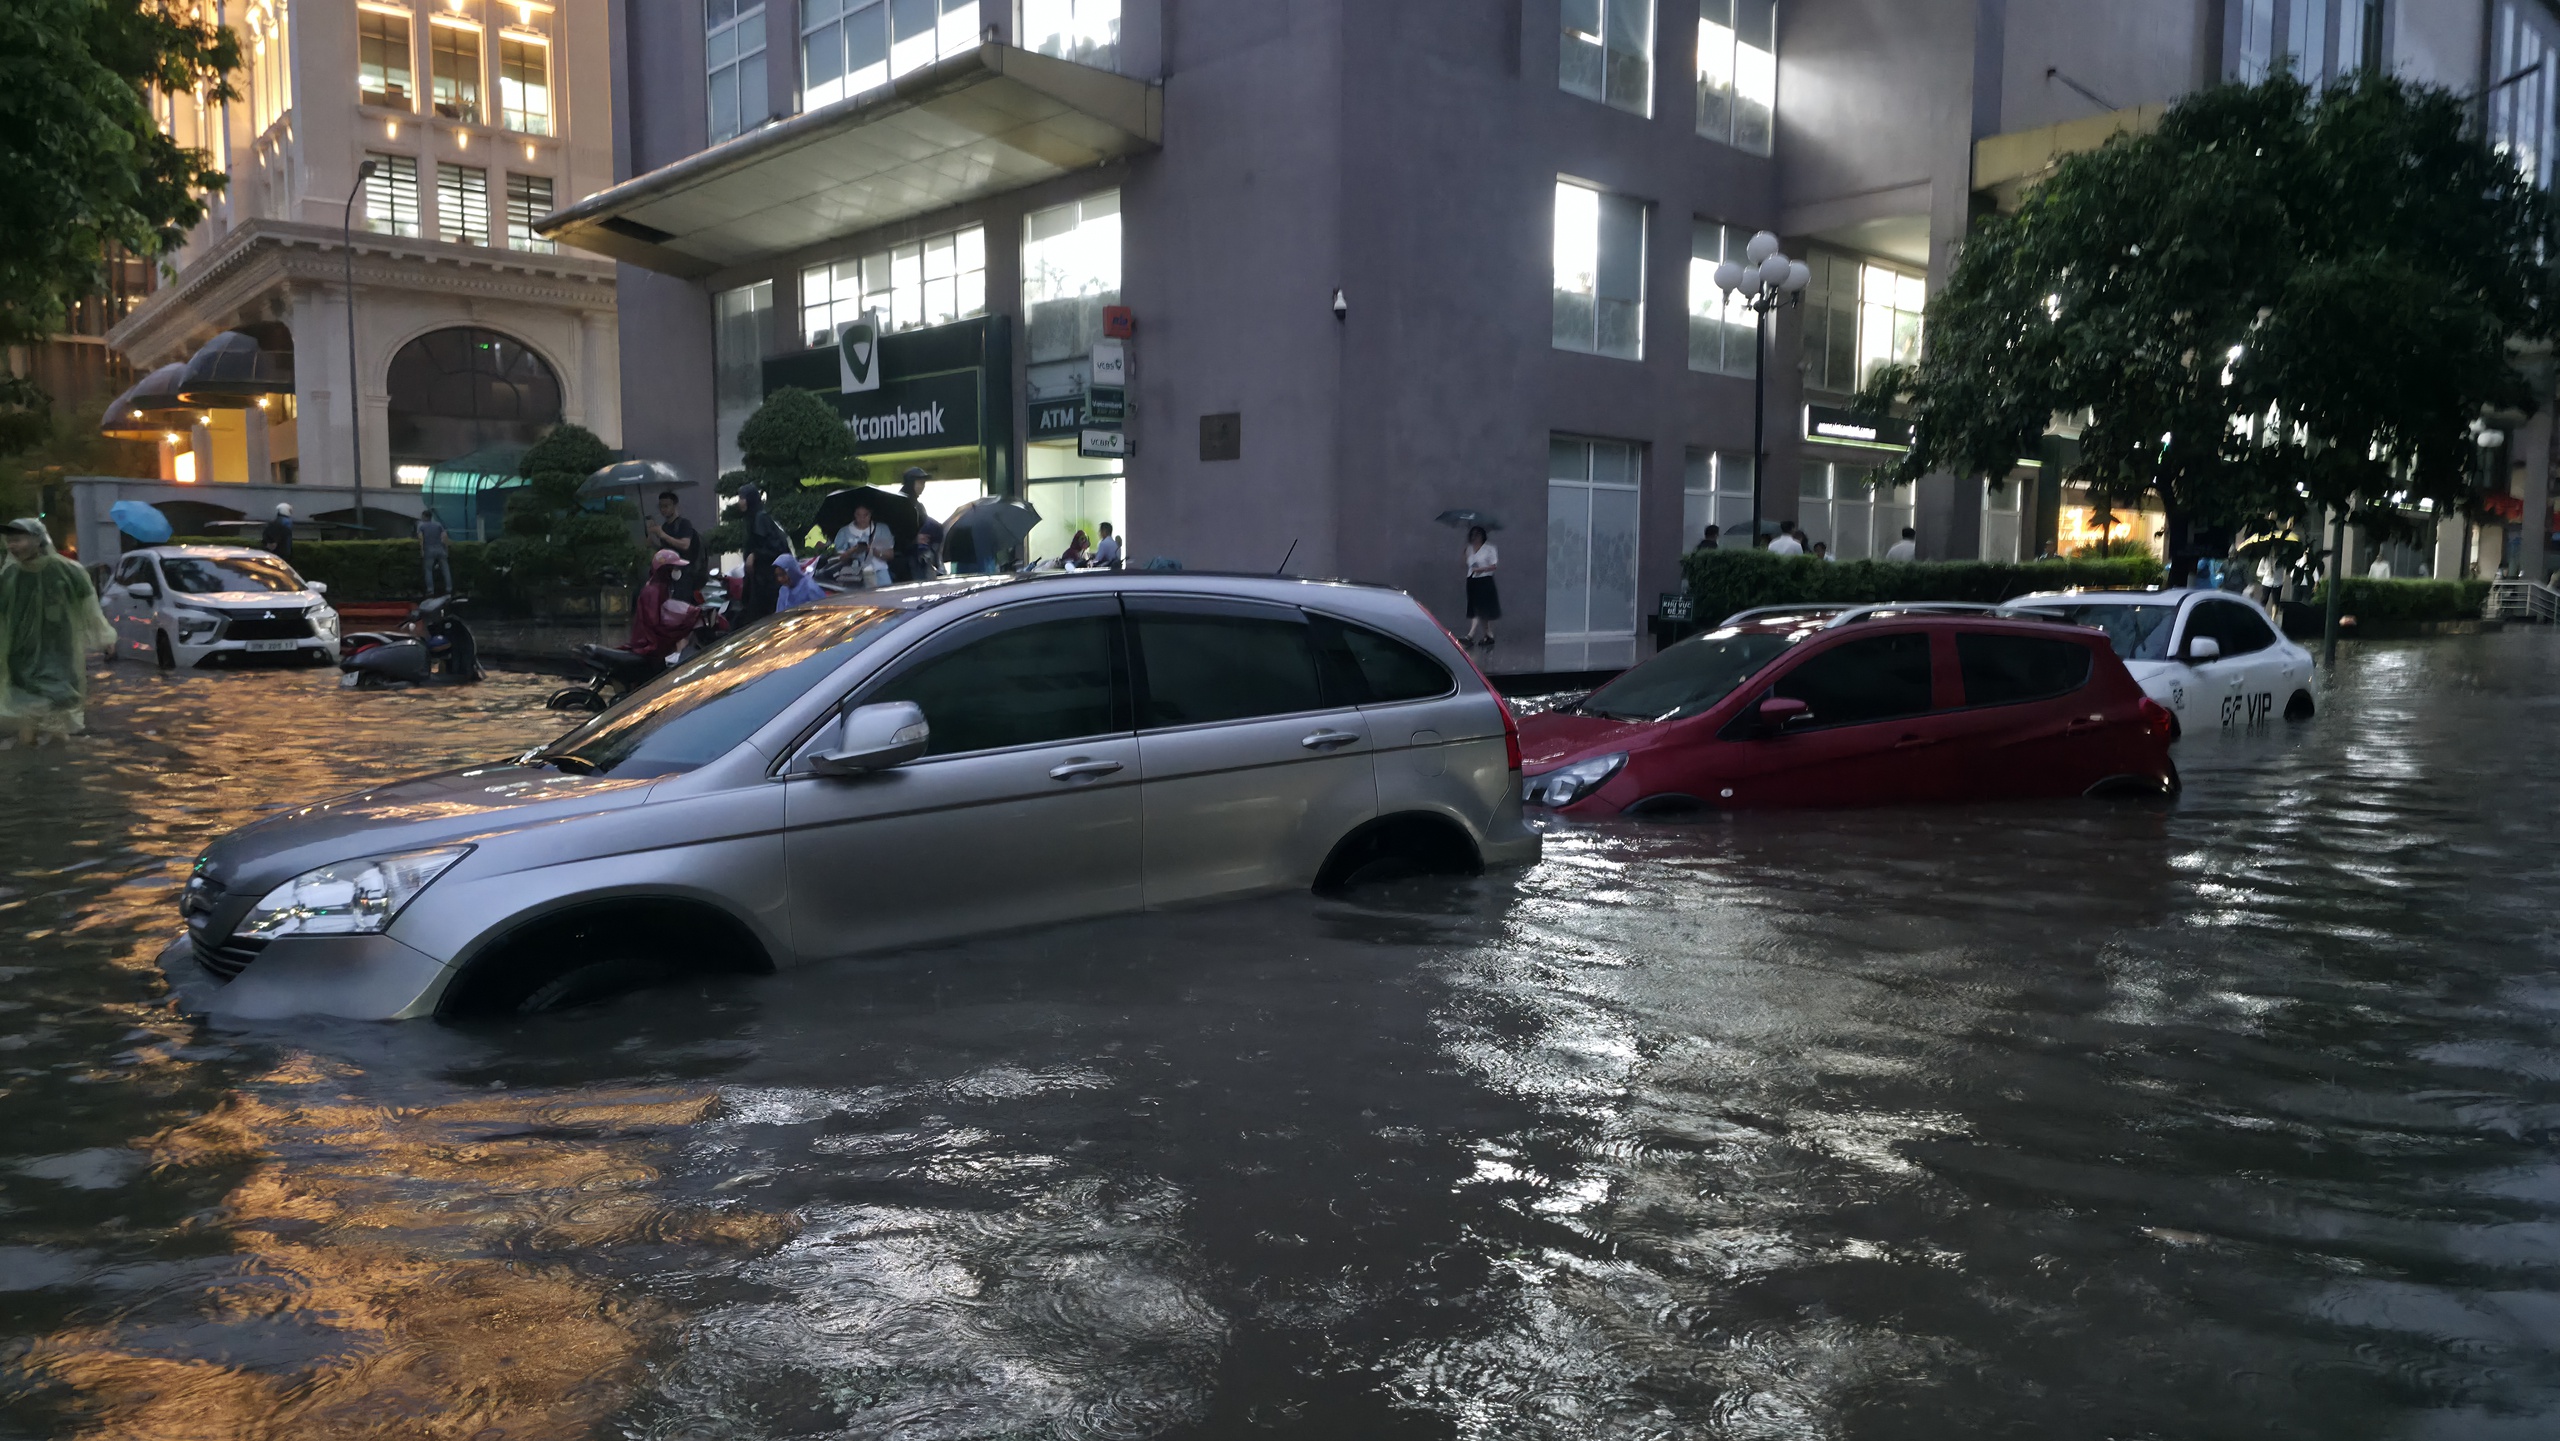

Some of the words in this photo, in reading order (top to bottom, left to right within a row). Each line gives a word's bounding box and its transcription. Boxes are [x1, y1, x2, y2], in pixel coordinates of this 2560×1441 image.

[843, 401, 945, 441] tcombank
[1040, 407, 1074, 429] ATM
[2247, 692, 2272, 723] VIP
